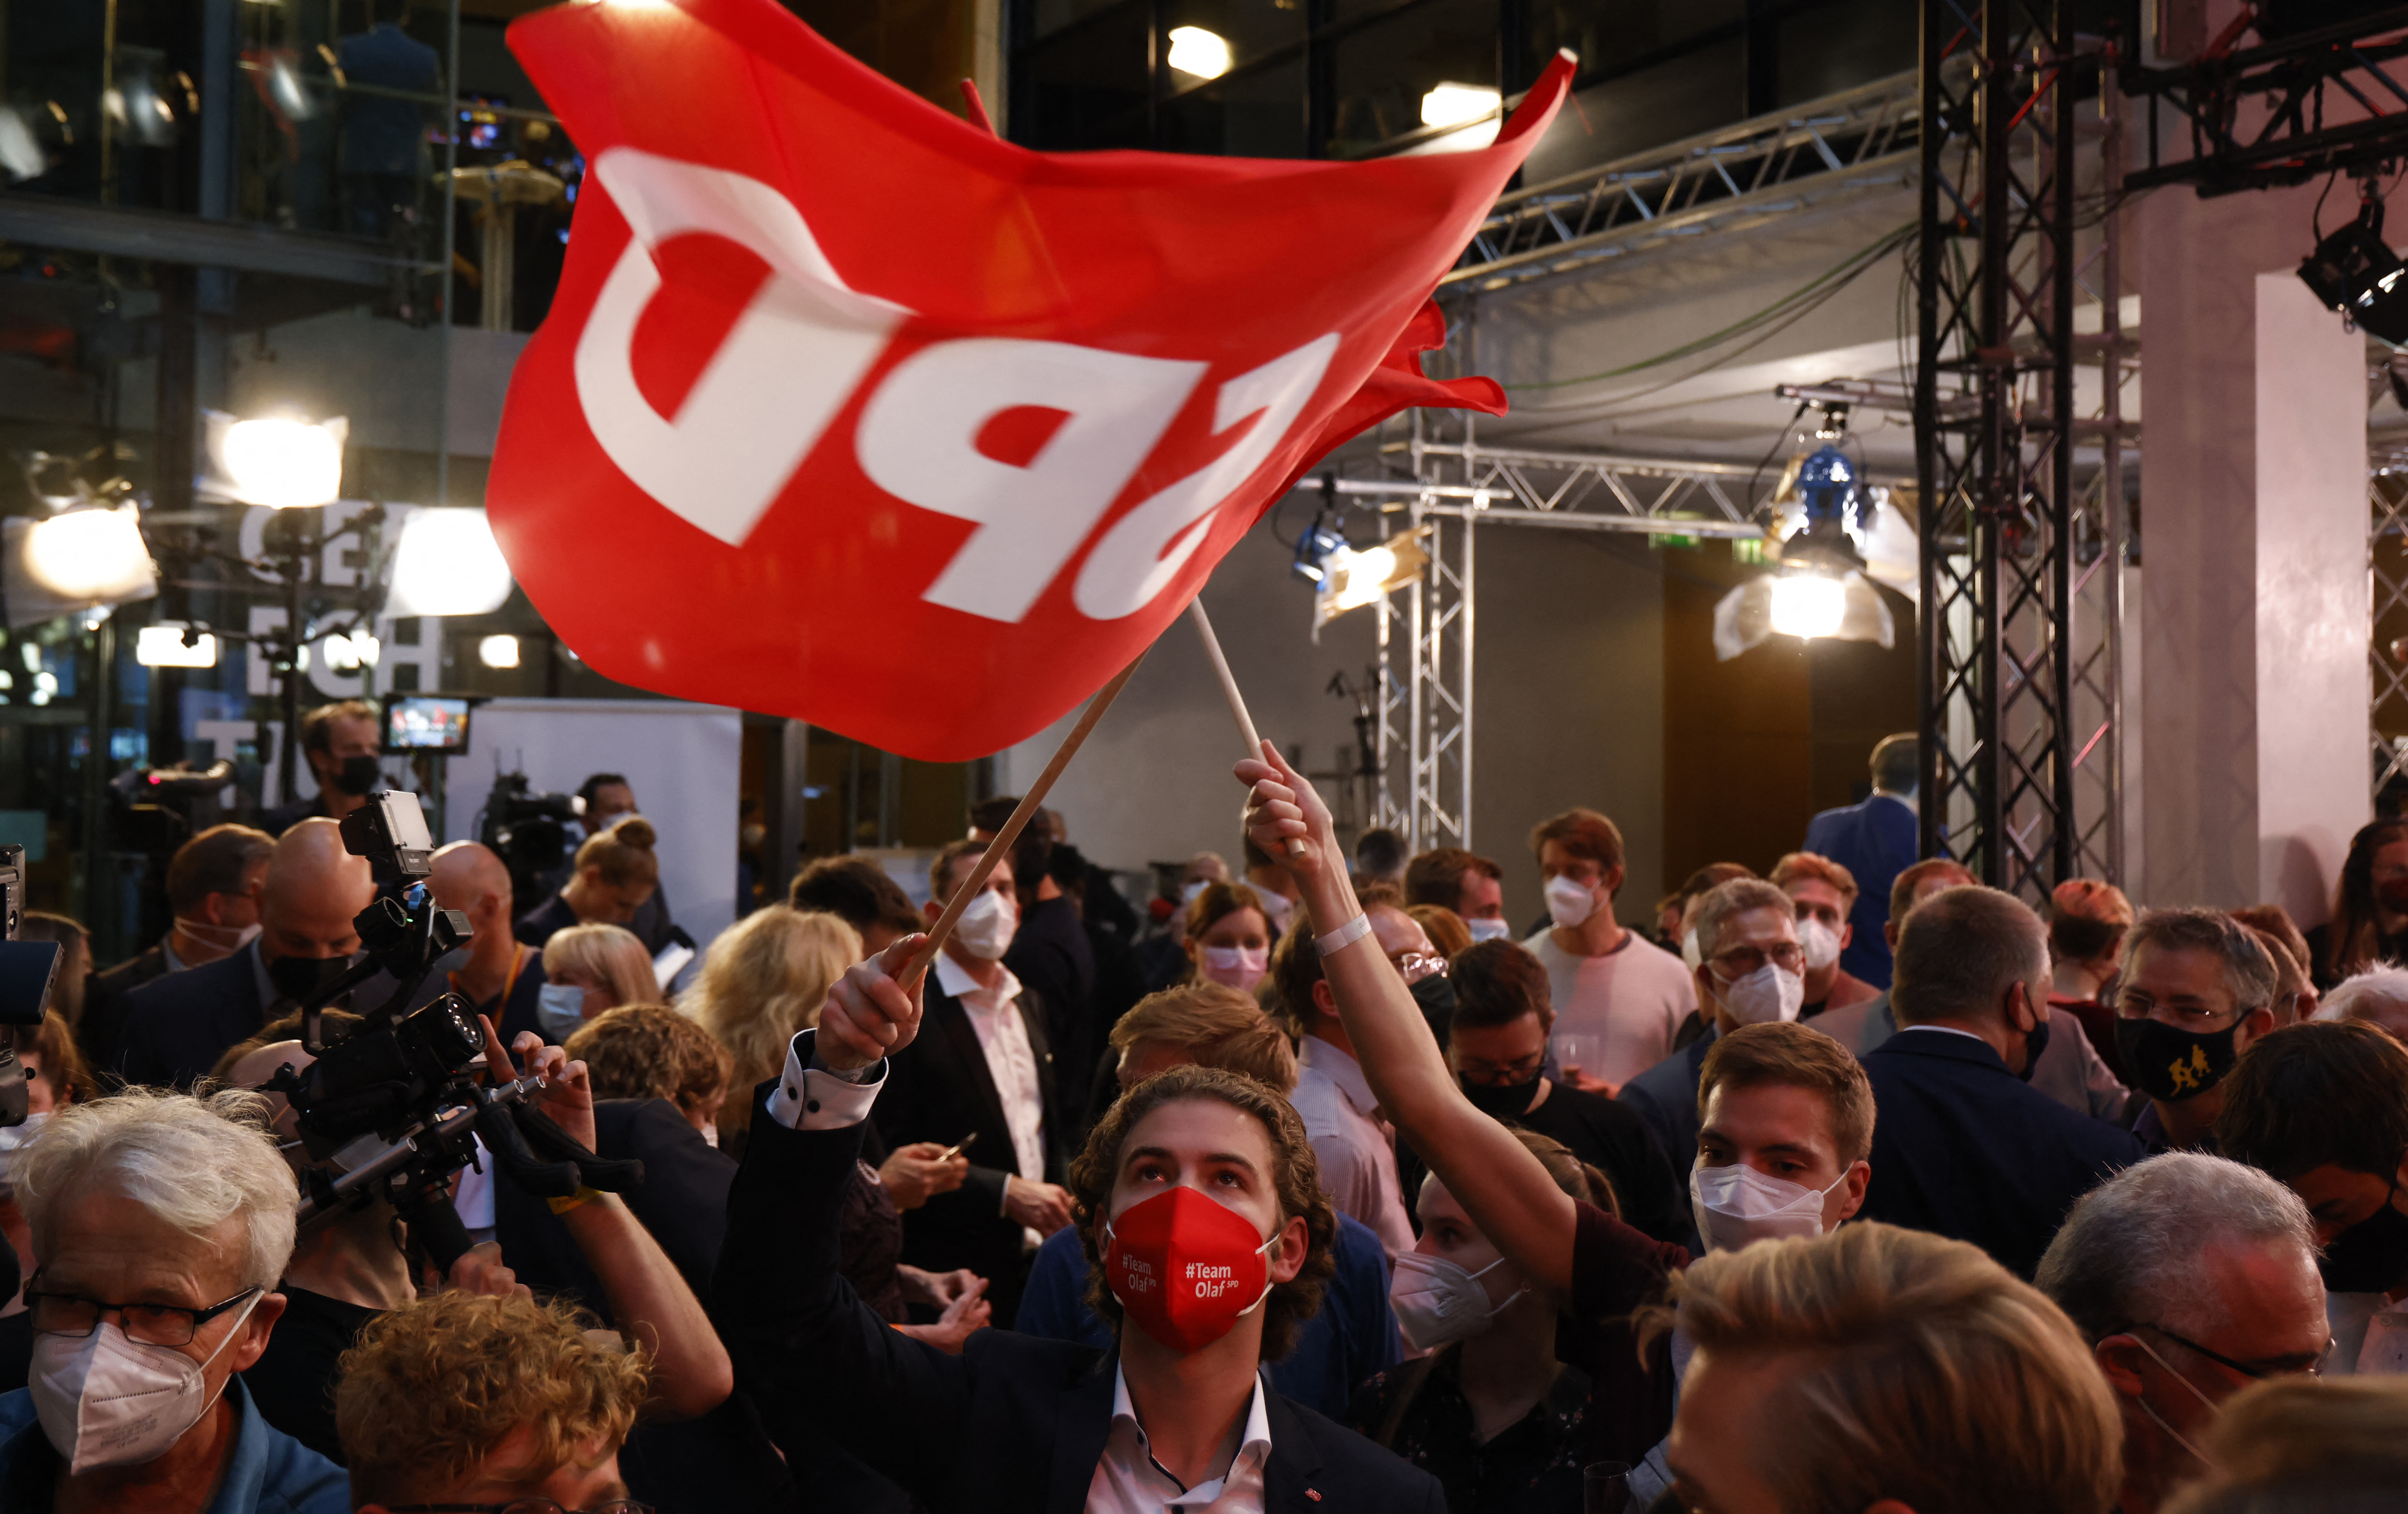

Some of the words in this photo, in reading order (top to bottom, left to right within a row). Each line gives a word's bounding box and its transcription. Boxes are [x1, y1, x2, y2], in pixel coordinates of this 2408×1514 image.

[1122, 1253, 1151, 1275] #Team
[1185, 1262, 1231, 1278] #Team
[1128, 1274, 1148, 1293] Olaf
[1195, 1280, 1226, 1298] Olaf
[1226, 1280, 1239, 1288] SPD
